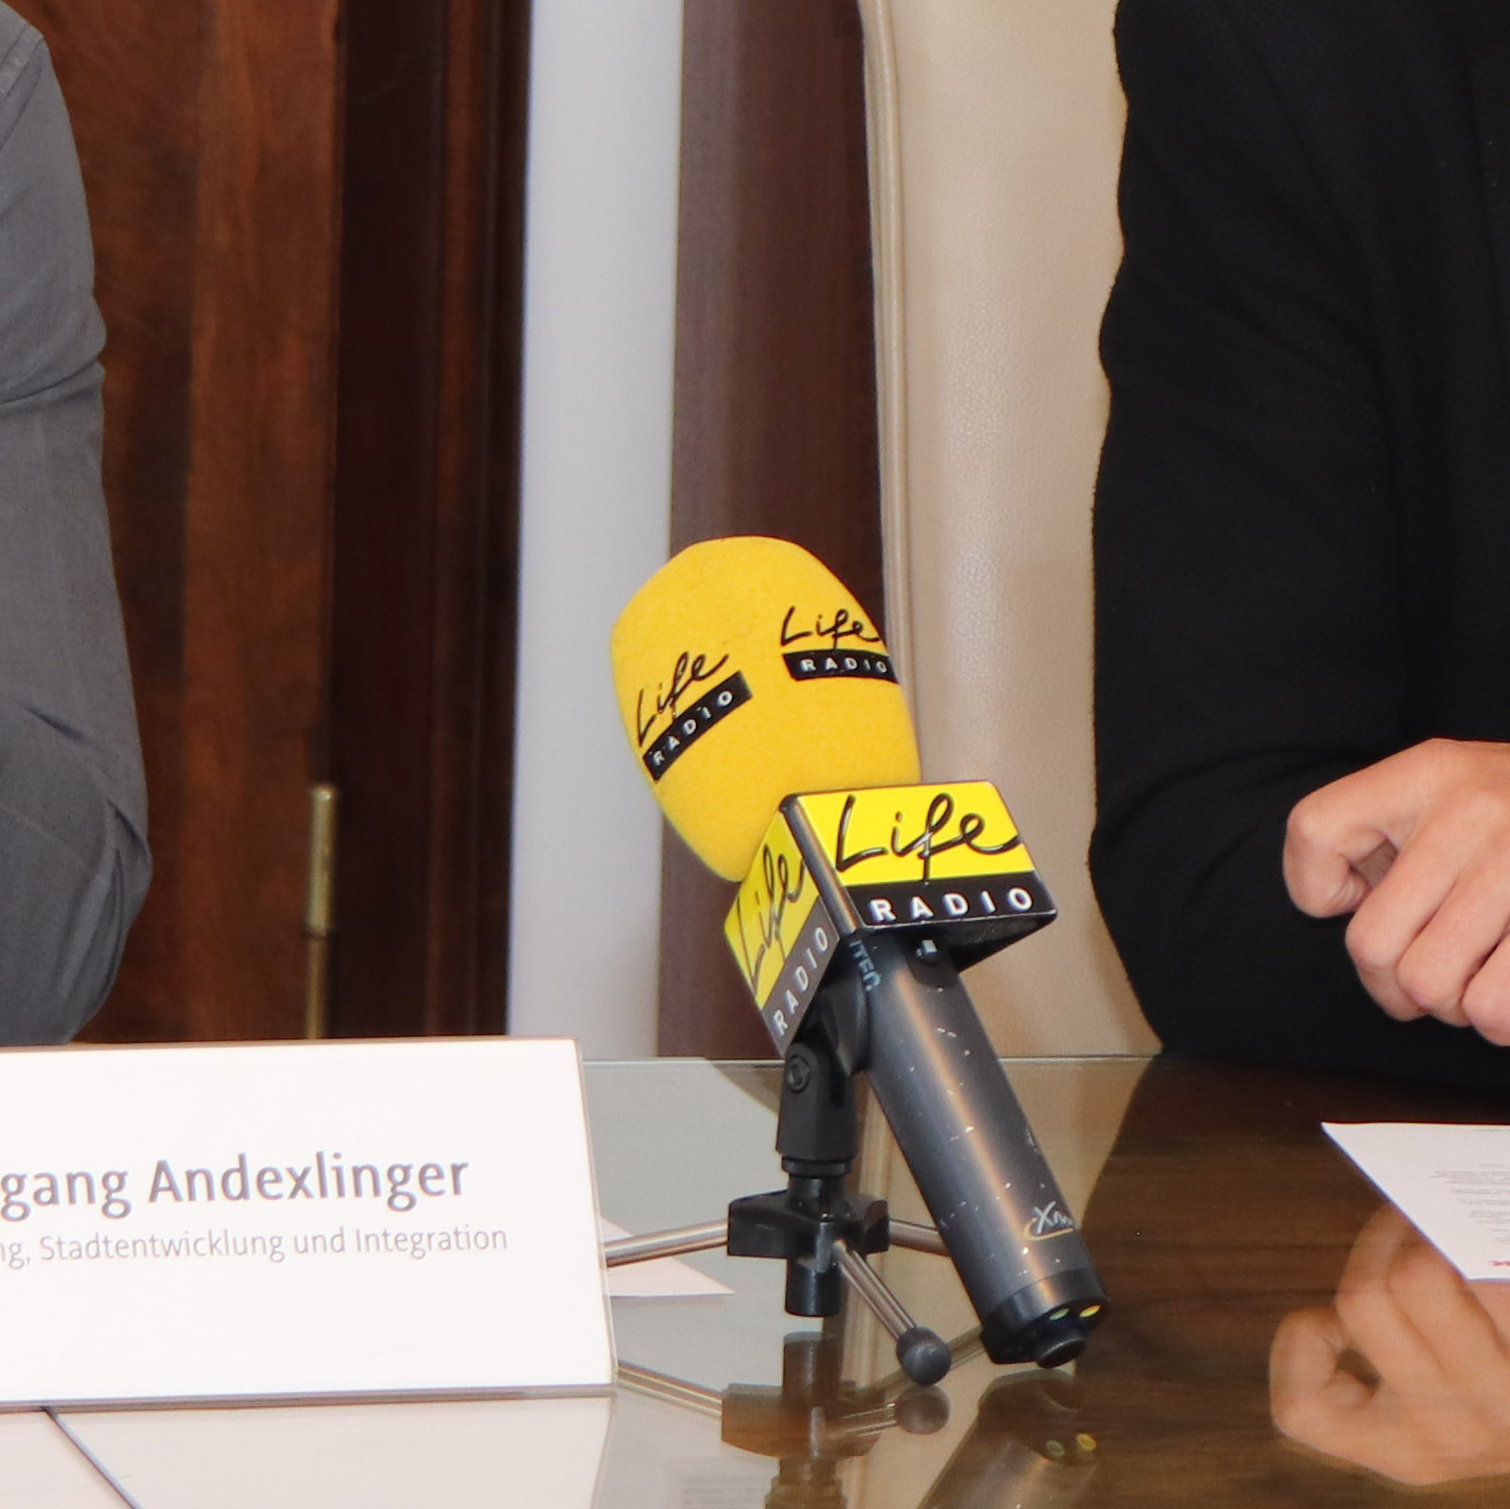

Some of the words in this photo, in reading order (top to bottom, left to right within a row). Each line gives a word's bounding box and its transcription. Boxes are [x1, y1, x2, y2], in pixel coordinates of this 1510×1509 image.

[780, 606, 881, 650] Life
[636, 651, 730, 748] Life
[800, 657, 888, 673] RADIO
[652, 691, 733, 766] RADIO
[836, 793, 1021, 881] Life
[736, 843, 806, 1002] Life
[868, 888, 1033, 922] RADIO
[772, 926, 830, 1036] RADIO
[148, 1151, 469, 1214] Andexlinger
[40, 1228, 286, 1263] Stadtentwicklung
[294, 1225, 346, 1255] und
[356, 1223, 508, 1259] Integration
